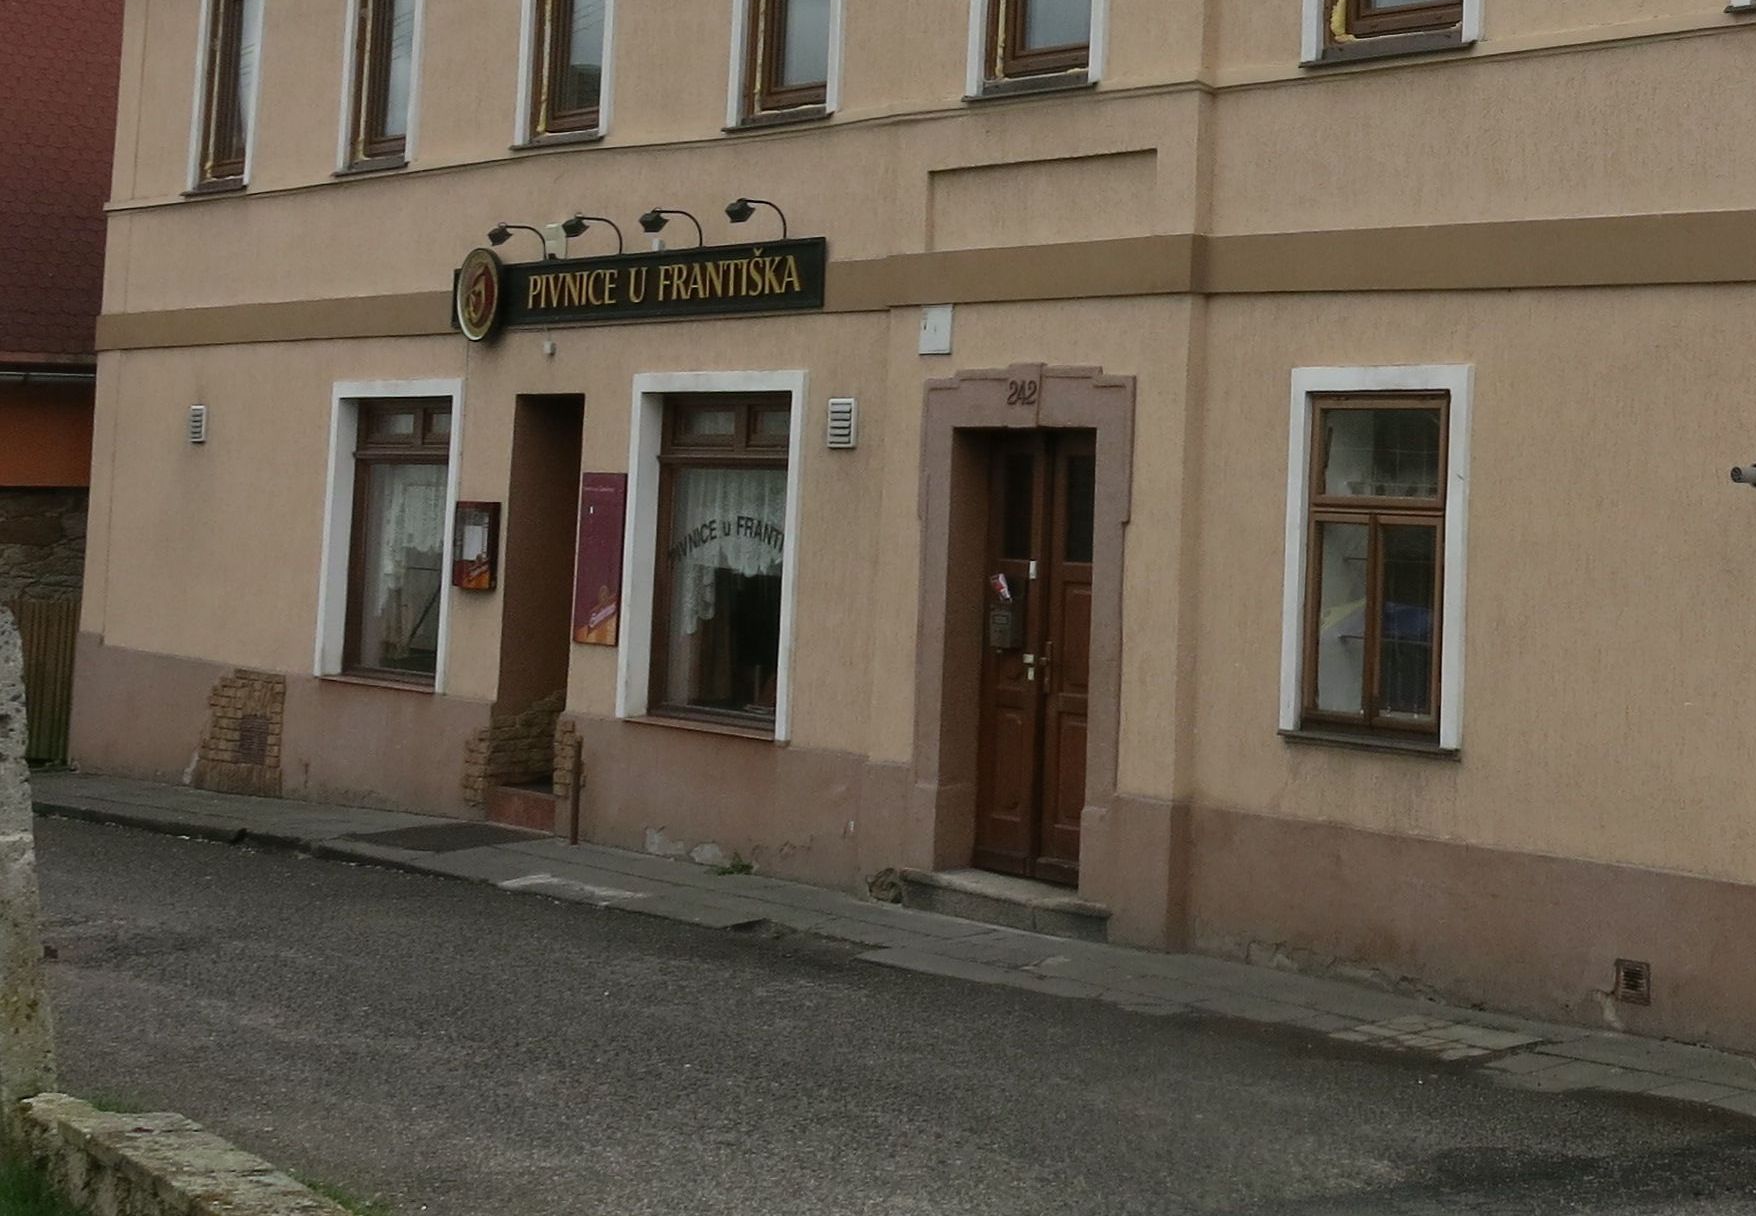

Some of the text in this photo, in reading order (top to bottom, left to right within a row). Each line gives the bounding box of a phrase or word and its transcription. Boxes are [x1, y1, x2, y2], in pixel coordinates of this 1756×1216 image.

[527, 247, 802, 310] PIVNICE U FRANTIŠKA
[1006, 379, 1038, 406] 242
[737, 515, 785, 553] FRANTI
